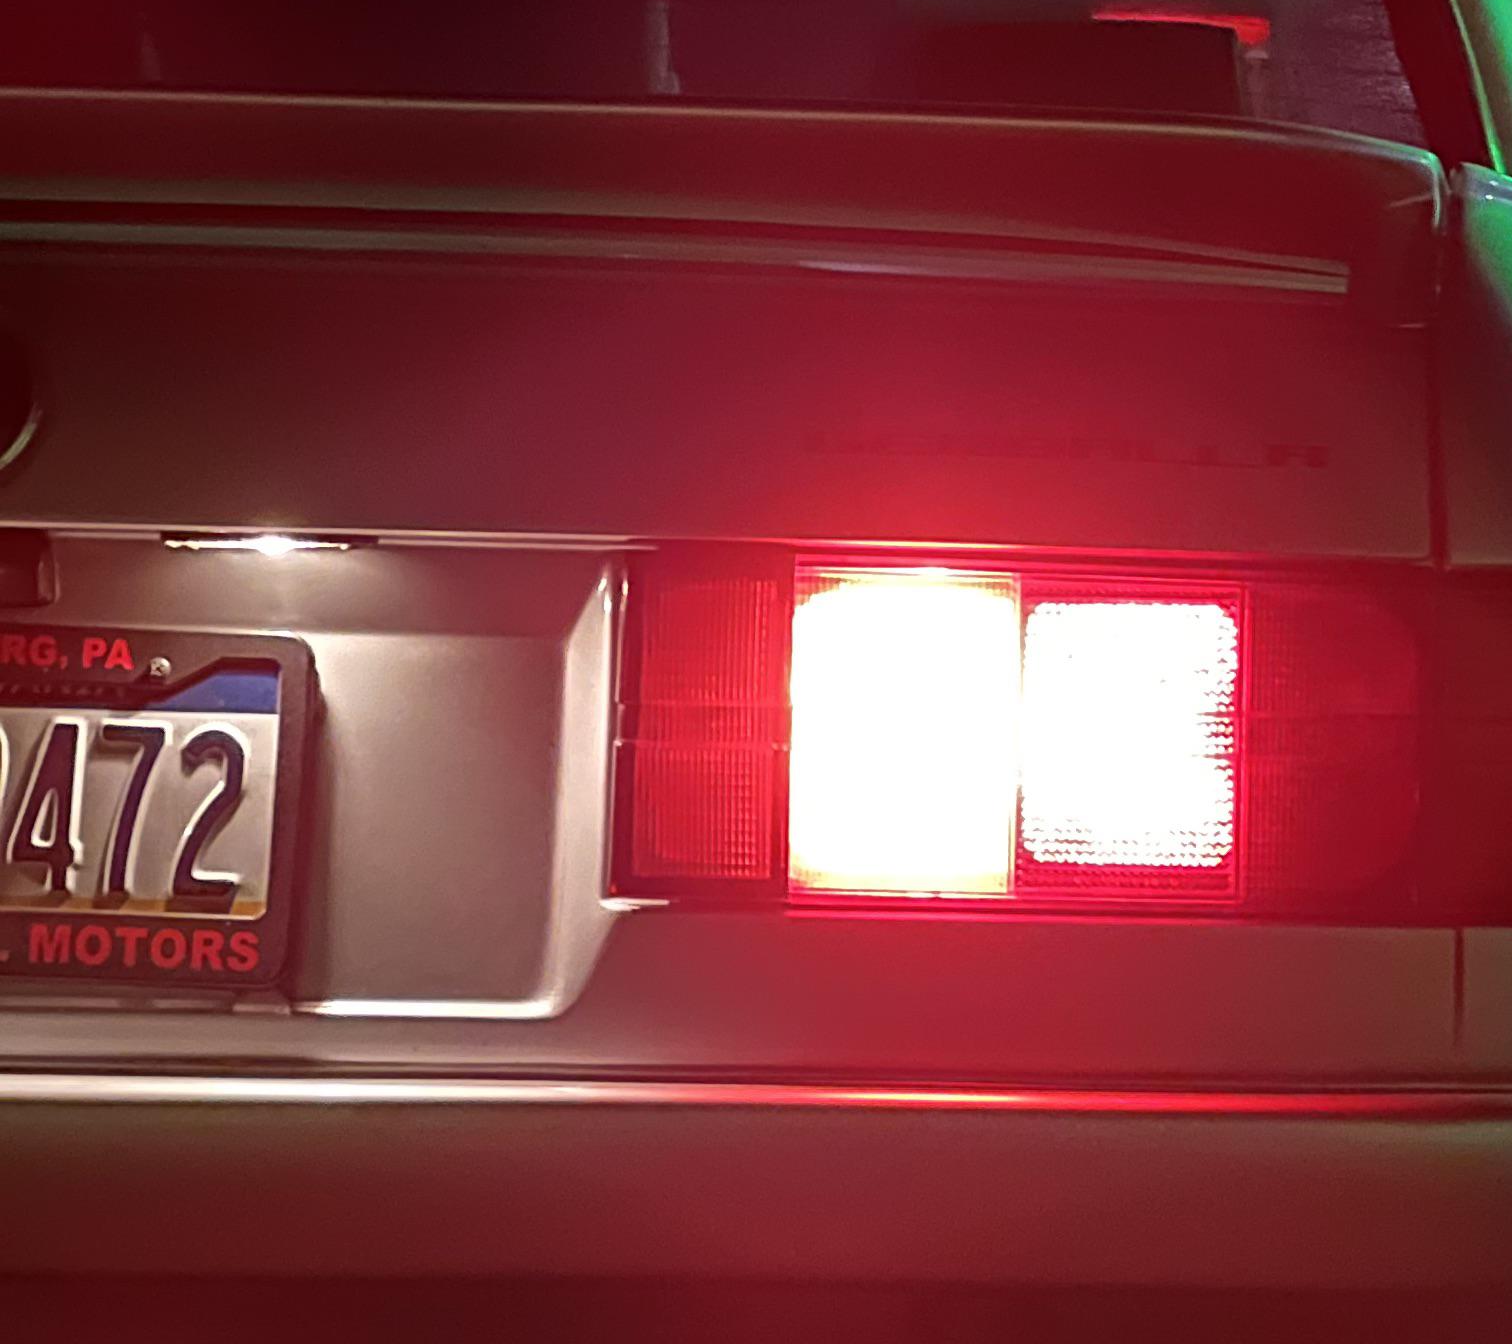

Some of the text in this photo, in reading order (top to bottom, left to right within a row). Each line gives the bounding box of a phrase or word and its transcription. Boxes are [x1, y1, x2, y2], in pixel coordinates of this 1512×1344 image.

[82, 638, 135, 671] PA
[0, 720, 246, 898] 472
[28, 923, 260, 972] MOTORS
